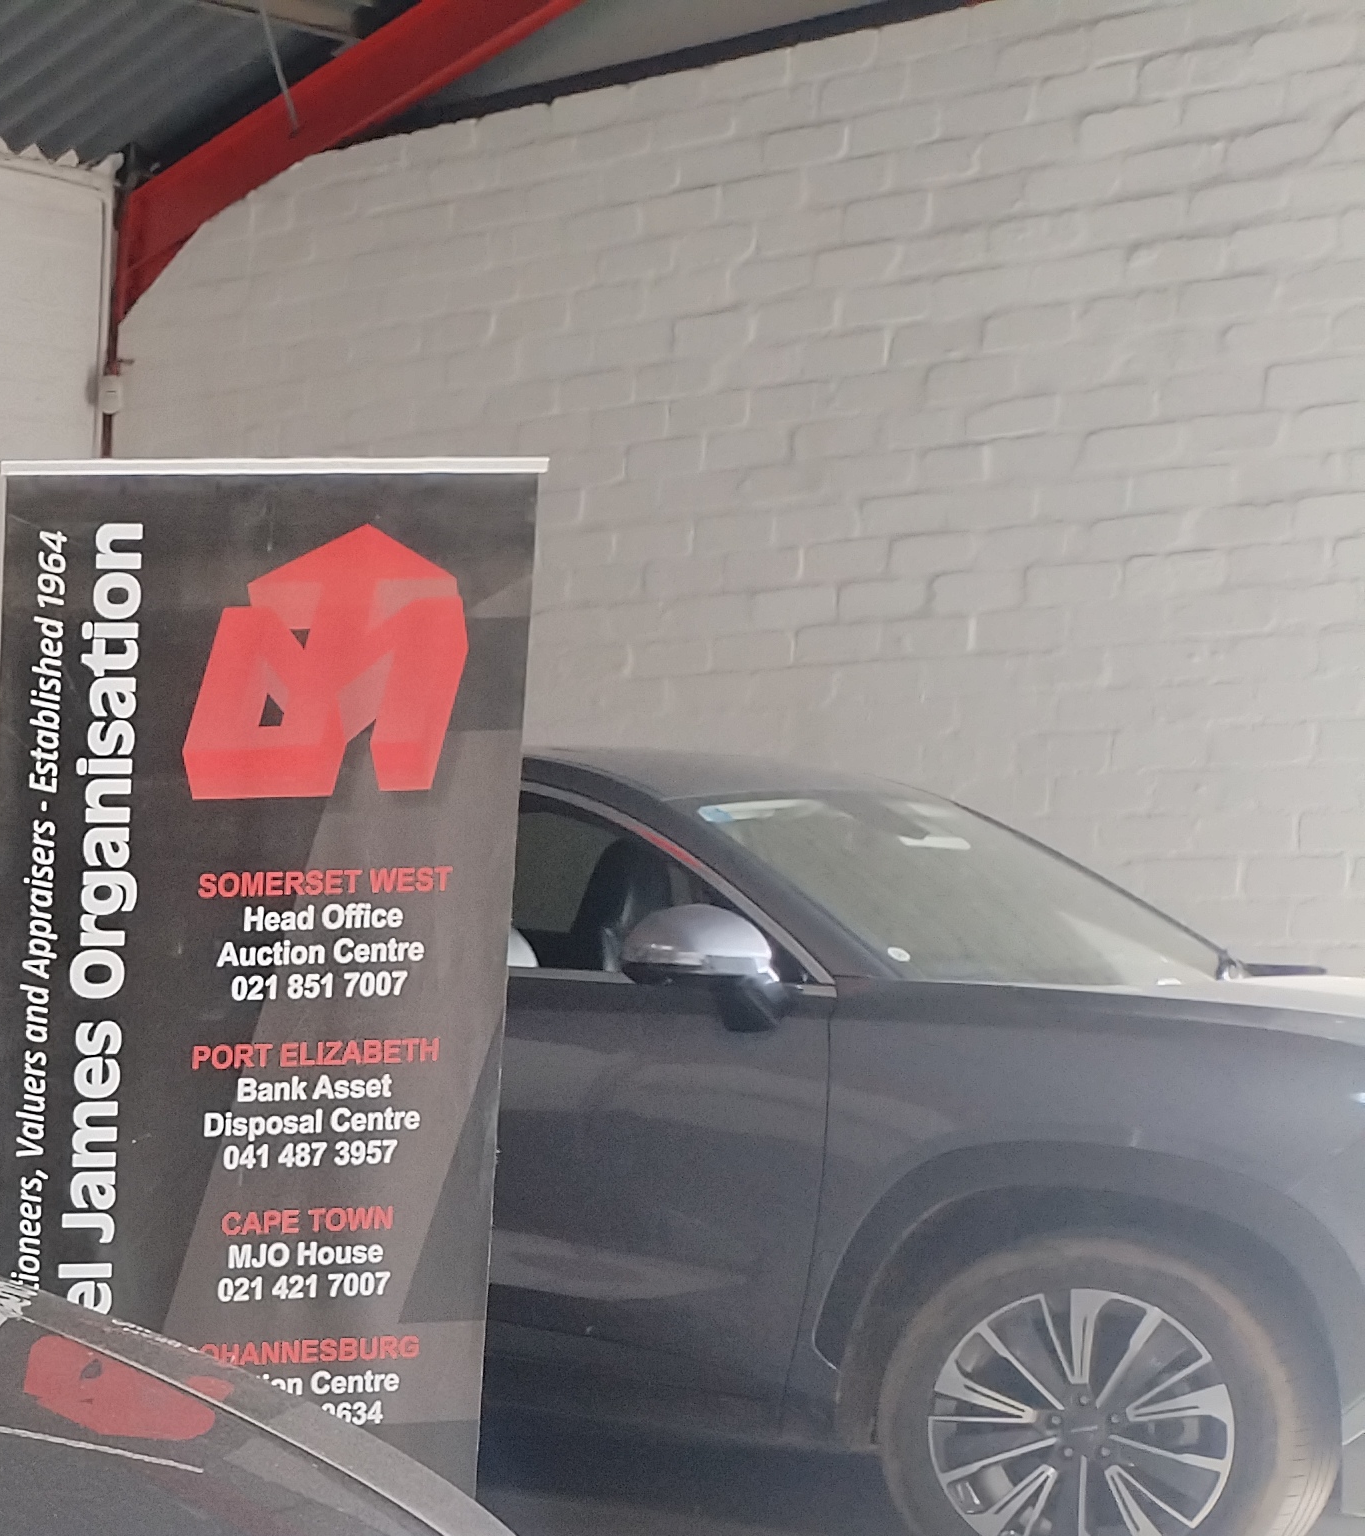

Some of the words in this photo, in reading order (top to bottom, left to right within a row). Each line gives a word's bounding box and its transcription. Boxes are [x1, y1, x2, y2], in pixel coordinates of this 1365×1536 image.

[34, 530, 68, 609] 1964
[29, 613, 66, 794] Established
[69, 522, 144, 999] Organisation
[197, 868, 362, 898] SOMERSET
[369, 865, 453, 894] WEST
[21, 818, 56, 979] Appraisers
[243, 905, 314, 933] Head
[322, 901, 403, 930] Office
[216, 940, 325, 969] Auction
[333, 937, 425, 965] Centre
[231, 974, 279, 1001] 021
[287, 972, 336, 999] 851
[343, 969, 408, 998] 7007
[19, 986, 50, 1045] and
[191, 1043, 272, 1071] PORT
[279, 1038, 440, 1068] ELIZABETH
[15, 1050, 48, 1159] Valuers
[237, 1076, 307, 1103] Bank
[312, 1073, 392, 1100] Asset
[61, 1019, 122, 1244] James
[203, 1111, 322, 1141] Disposal
[330, 1107, 420, 1133] Centre
[223, 1144, 270, 1171] 041
[278, 1142, 327, 1167] 487
[334, 1140, 398, 1166] 3957
[11, 1169, 48, 1290] ioneers,
[221, 1209, 299, 1237] CAPE
[307, 1206, 394, 1233] TOWN
[228, 1243, 290, 1270] MJO
[296, 1240, 384, 1265] House
[218, 1277, 263, 1302] 021
[268, 1274, 319, 1300] 421
[327, 1271, 391, 1297] 7007
[310, 1370, 400, 1395] Centre
